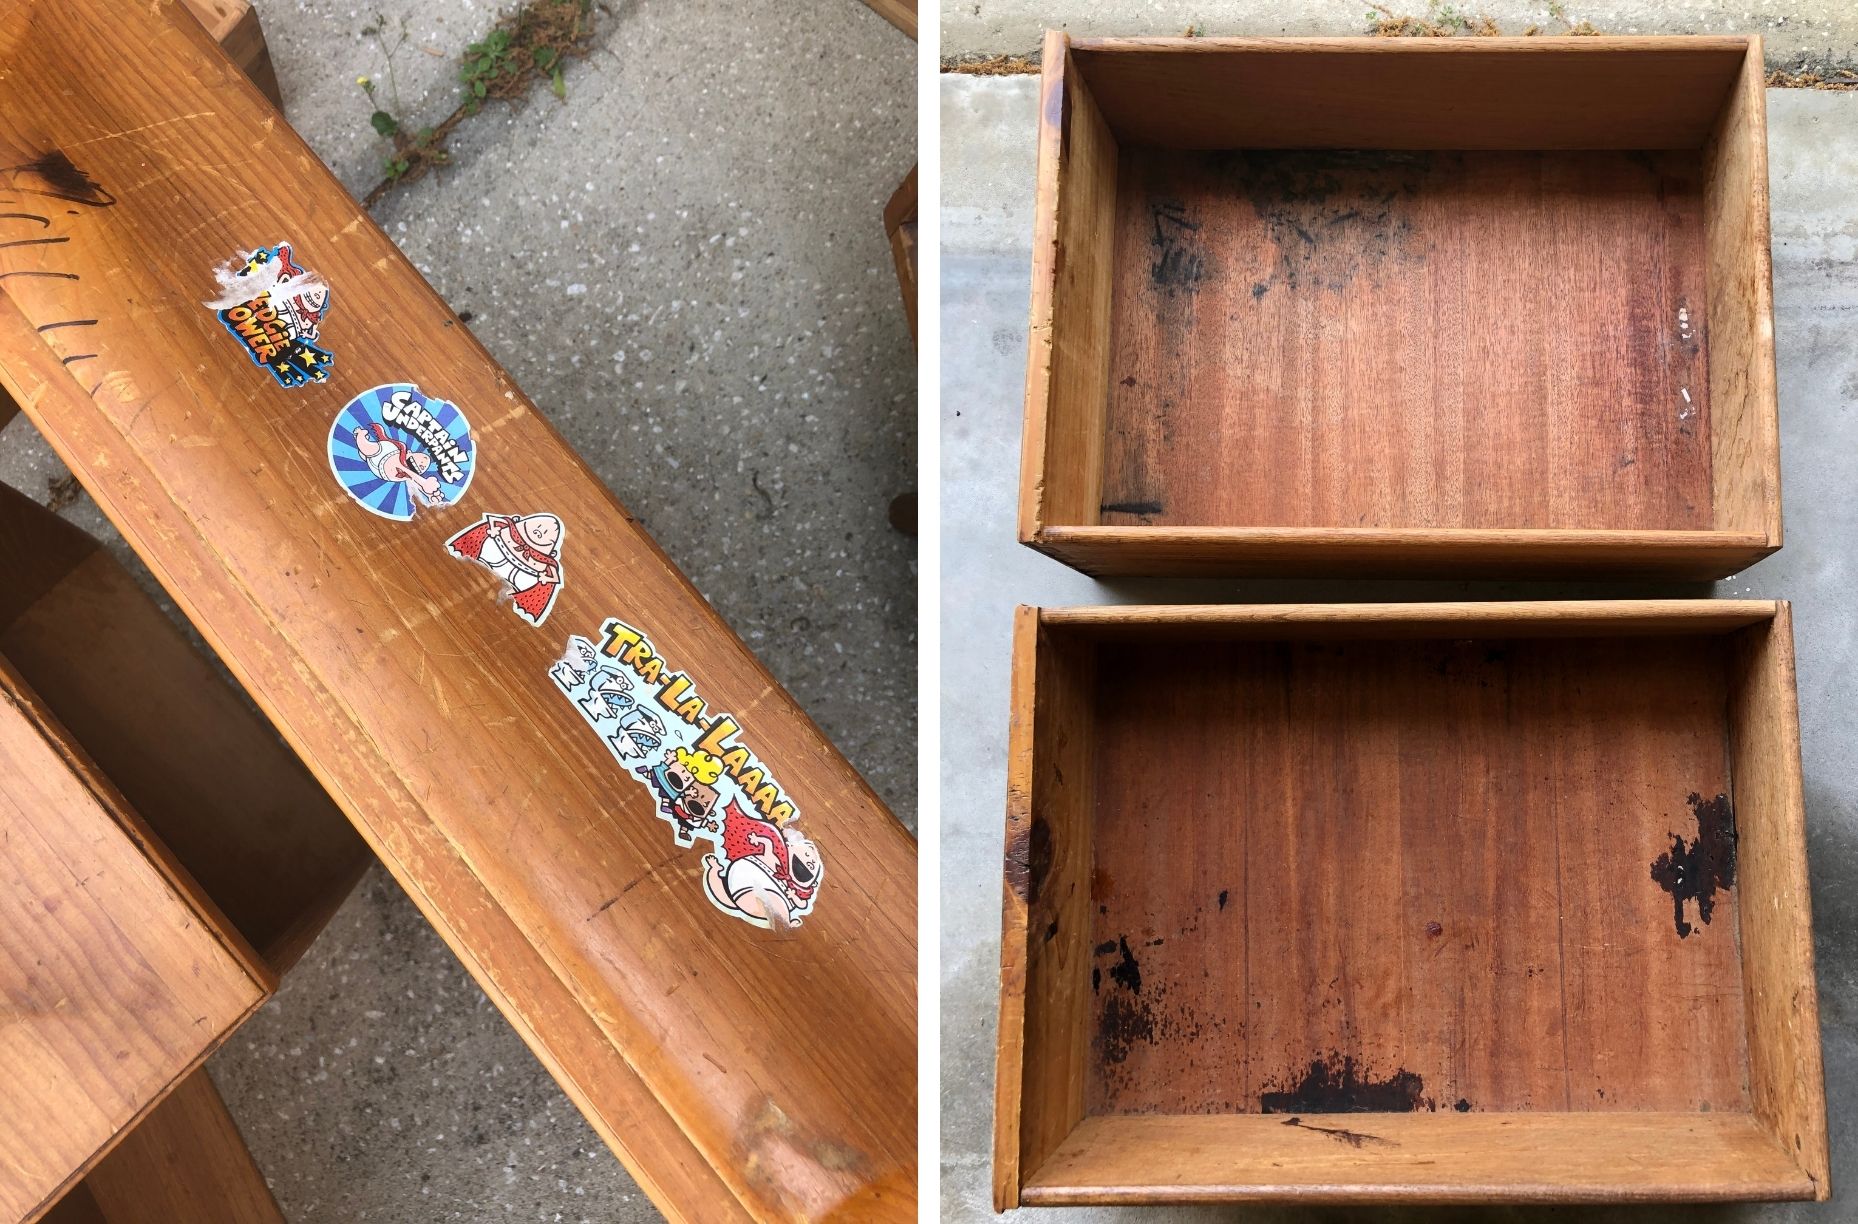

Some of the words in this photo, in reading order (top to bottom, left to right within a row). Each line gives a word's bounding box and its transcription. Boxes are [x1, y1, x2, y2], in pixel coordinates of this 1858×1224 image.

[228, 306, 277, 364] OWER
[382, 401, 465, 485] UNDERPANTS
[602, 622, 796, 829] TRA-LA-LAAAA
